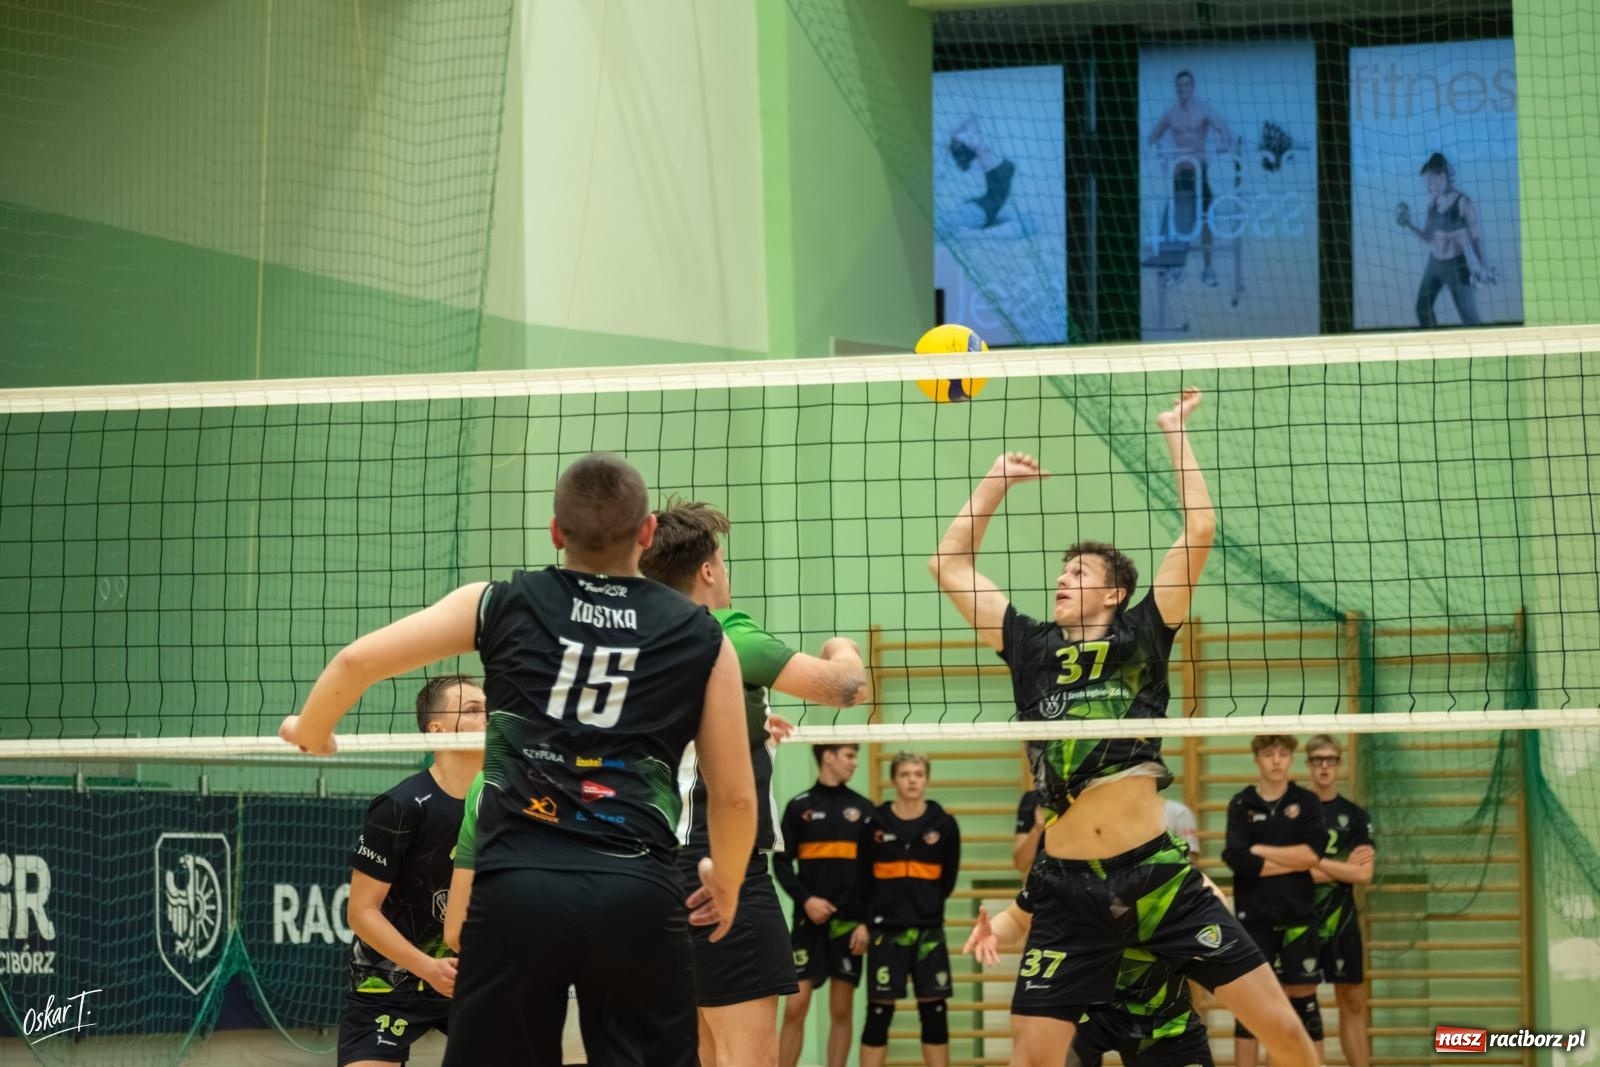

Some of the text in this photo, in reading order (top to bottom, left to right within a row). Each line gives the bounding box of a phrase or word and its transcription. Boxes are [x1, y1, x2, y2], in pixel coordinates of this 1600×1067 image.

[570, 597, 637, 630] KOSTKA
[1055, 641, 1110, 684] 37
[546, 636, 640, 729] 15
[876, 966, 891, 985] 6
[1020, 948, 1067, 978] 37
